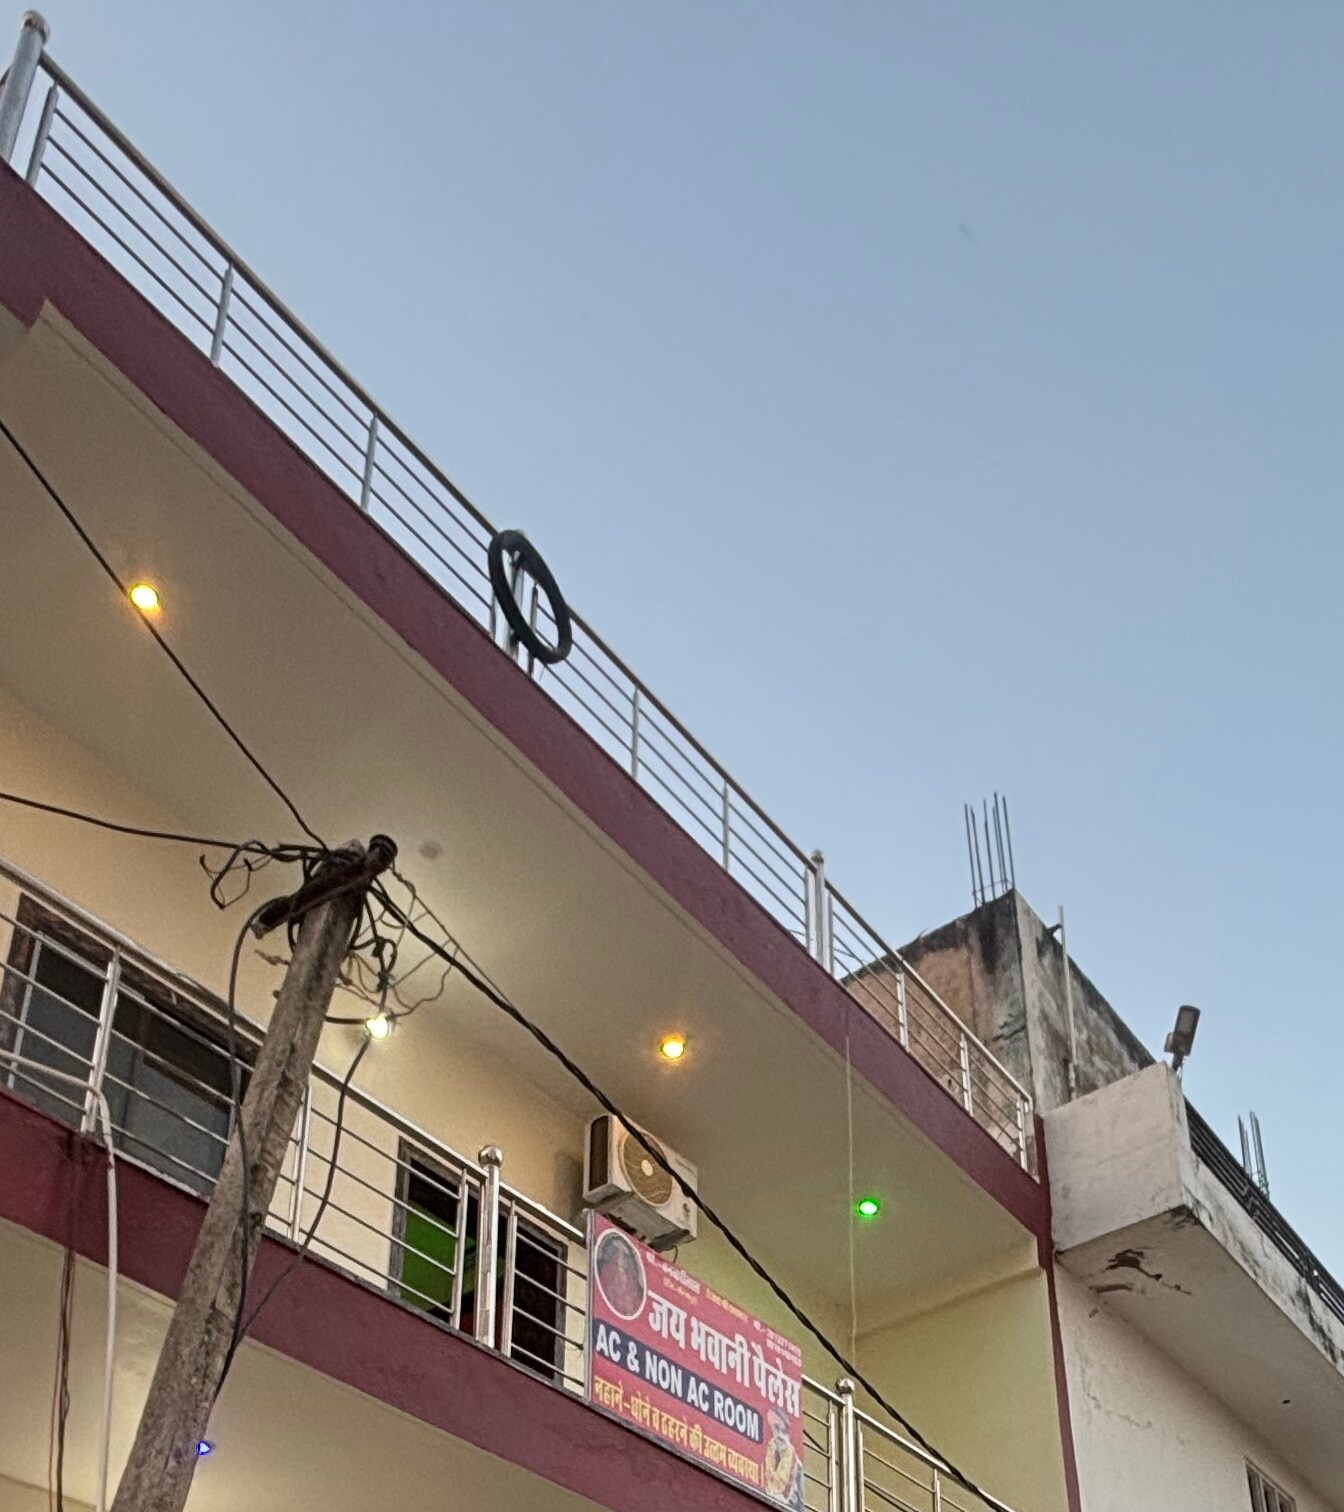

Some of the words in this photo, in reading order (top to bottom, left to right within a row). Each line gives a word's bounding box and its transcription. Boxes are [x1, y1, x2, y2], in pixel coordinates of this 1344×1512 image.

[596, 1324, 621, 1363] AC
[627, 1341, 640, 1374] &
[645, 1350, 683, 1398] NON
[687, 1376, 710, 1412] AC
[713, 1390, 760, 1442] ROOM
[647, 1290, 687, 1350] जय
[690, 1316, 750, 1389] भवानी
[751, 1341, 801, 1419] पैलेस
[689, 1423, 703, 1454] की
